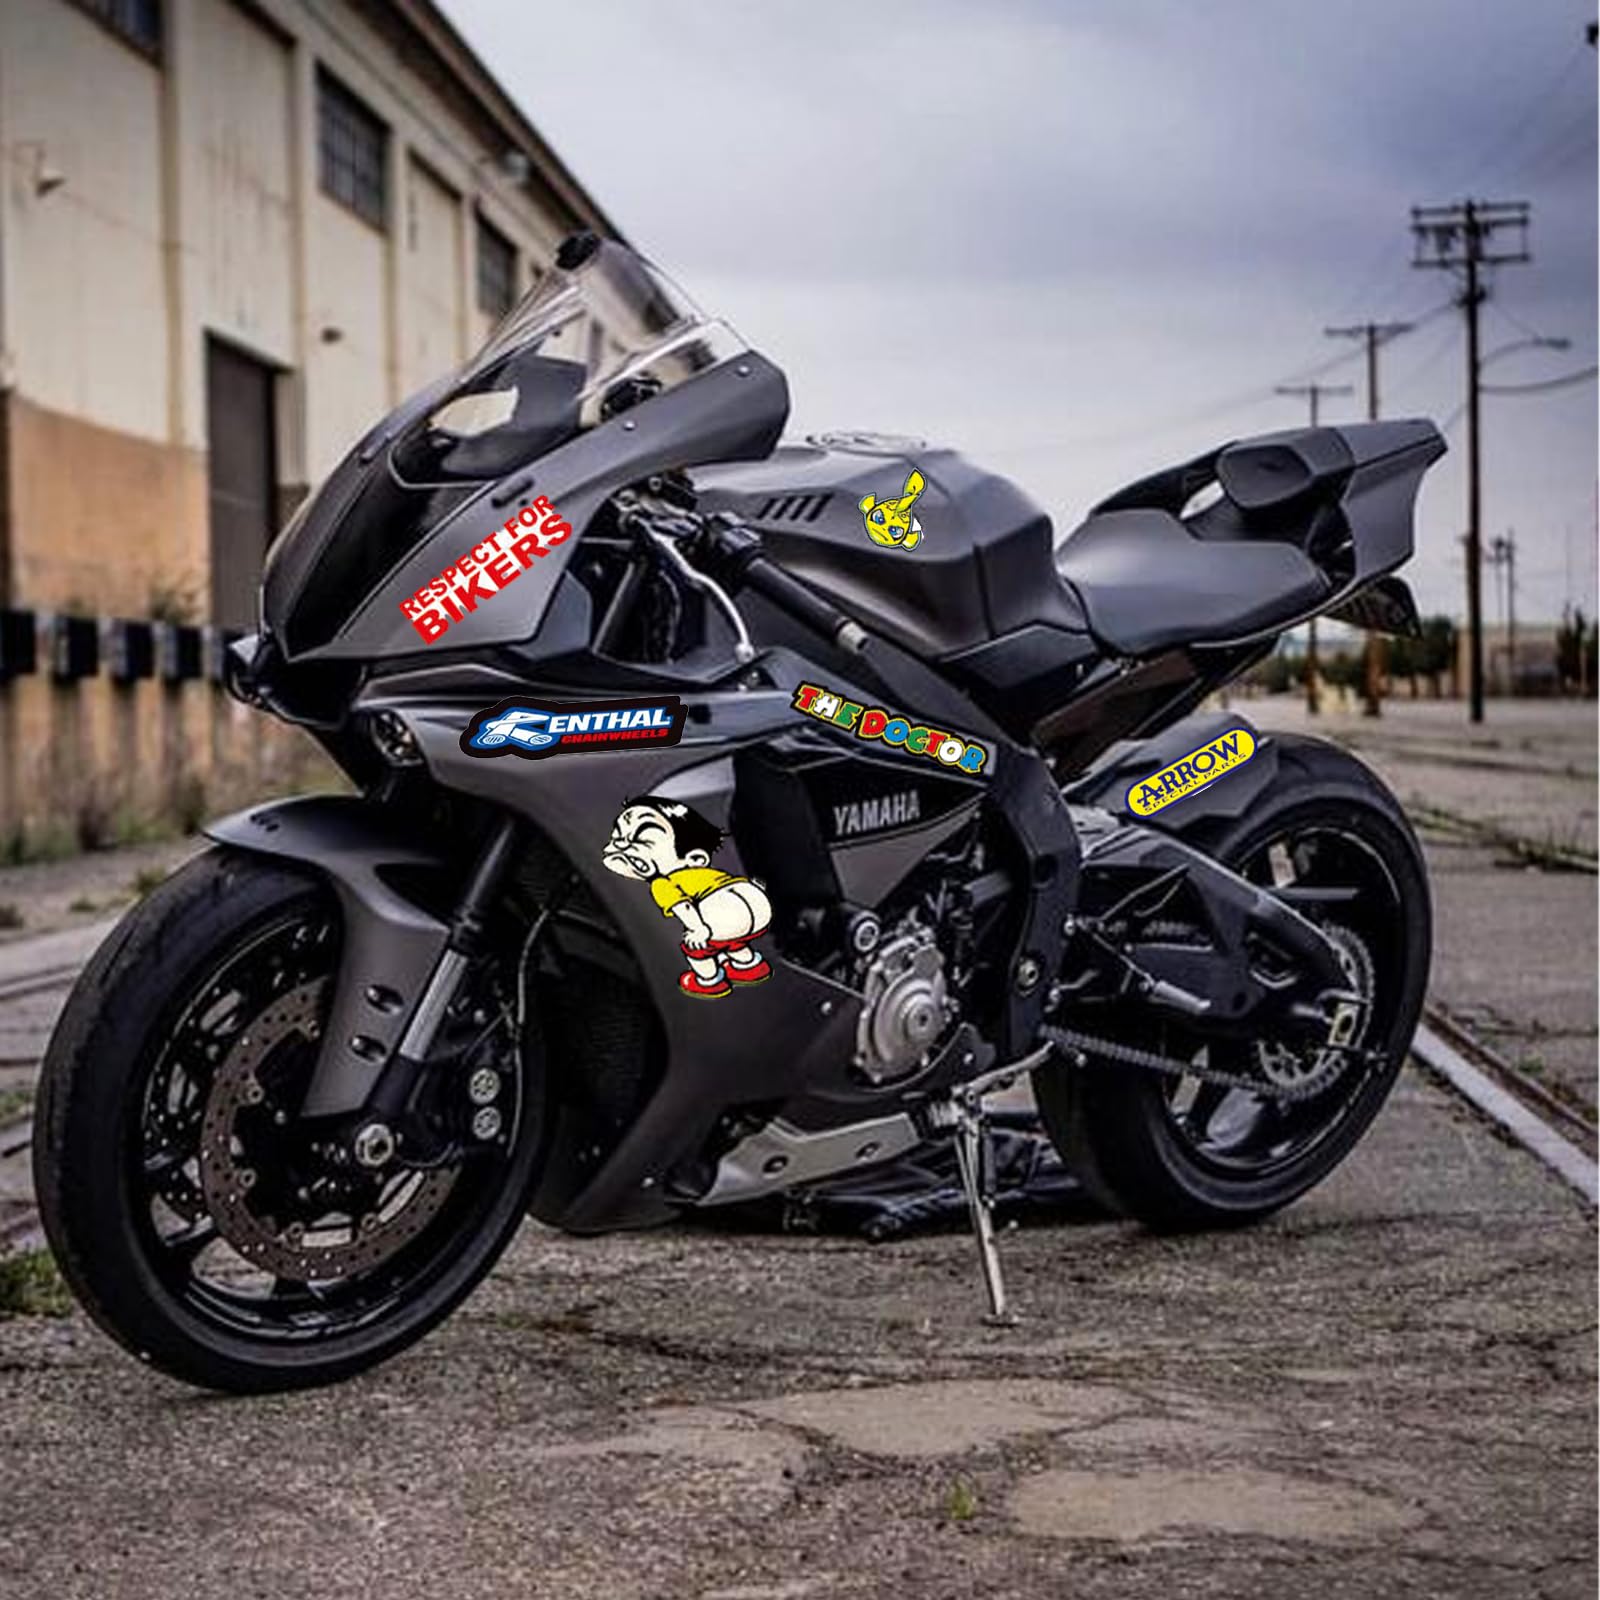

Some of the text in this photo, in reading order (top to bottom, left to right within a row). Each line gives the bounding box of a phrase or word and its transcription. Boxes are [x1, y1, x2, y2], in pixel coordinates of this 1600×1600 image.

[397, 495, 556, 620] RESPECT FOR
[412, 514, 573, 645] BIKERS
[561, 729, 669, 744] CHAINWHEELS
[796, 684, 986, 773] THE DOCTOR
[1136, 732, 1240, 808] ARROW
[1144, 752, 1247, 812] SPECIAL PARTS
[833, 790, 921, 836] YAMAHA
